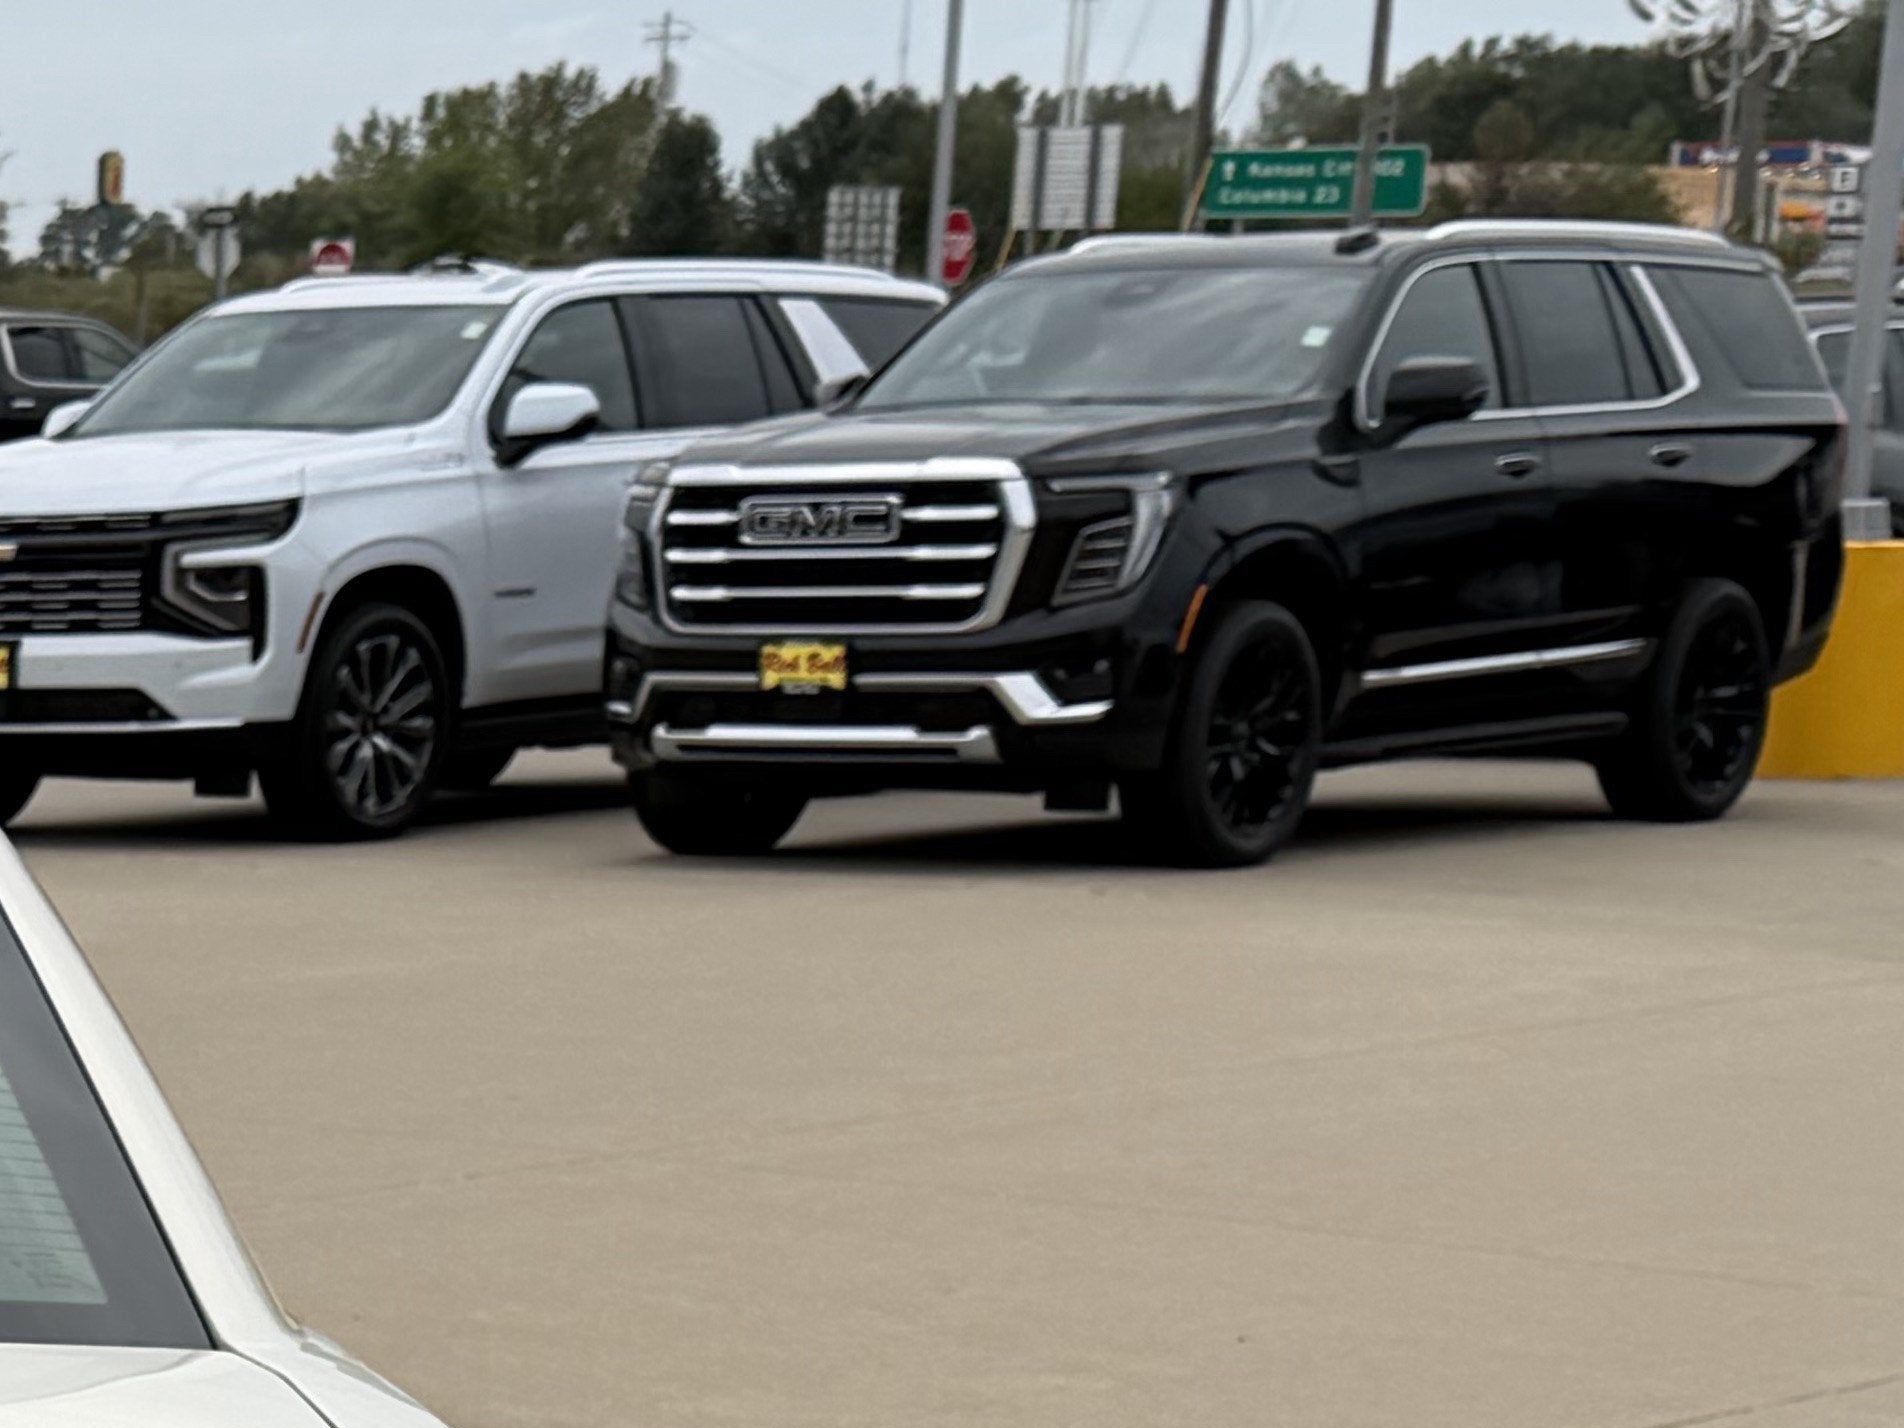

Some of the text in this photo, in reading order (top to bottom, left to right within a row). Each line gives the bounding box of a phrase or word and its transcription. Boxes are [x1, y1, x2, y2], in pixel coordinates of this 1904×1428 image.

[1247, 159, 1316, 178] Kansas
[1217, 185, 1307, 205] Columbia
[750, 504, 890, 539] GMC
